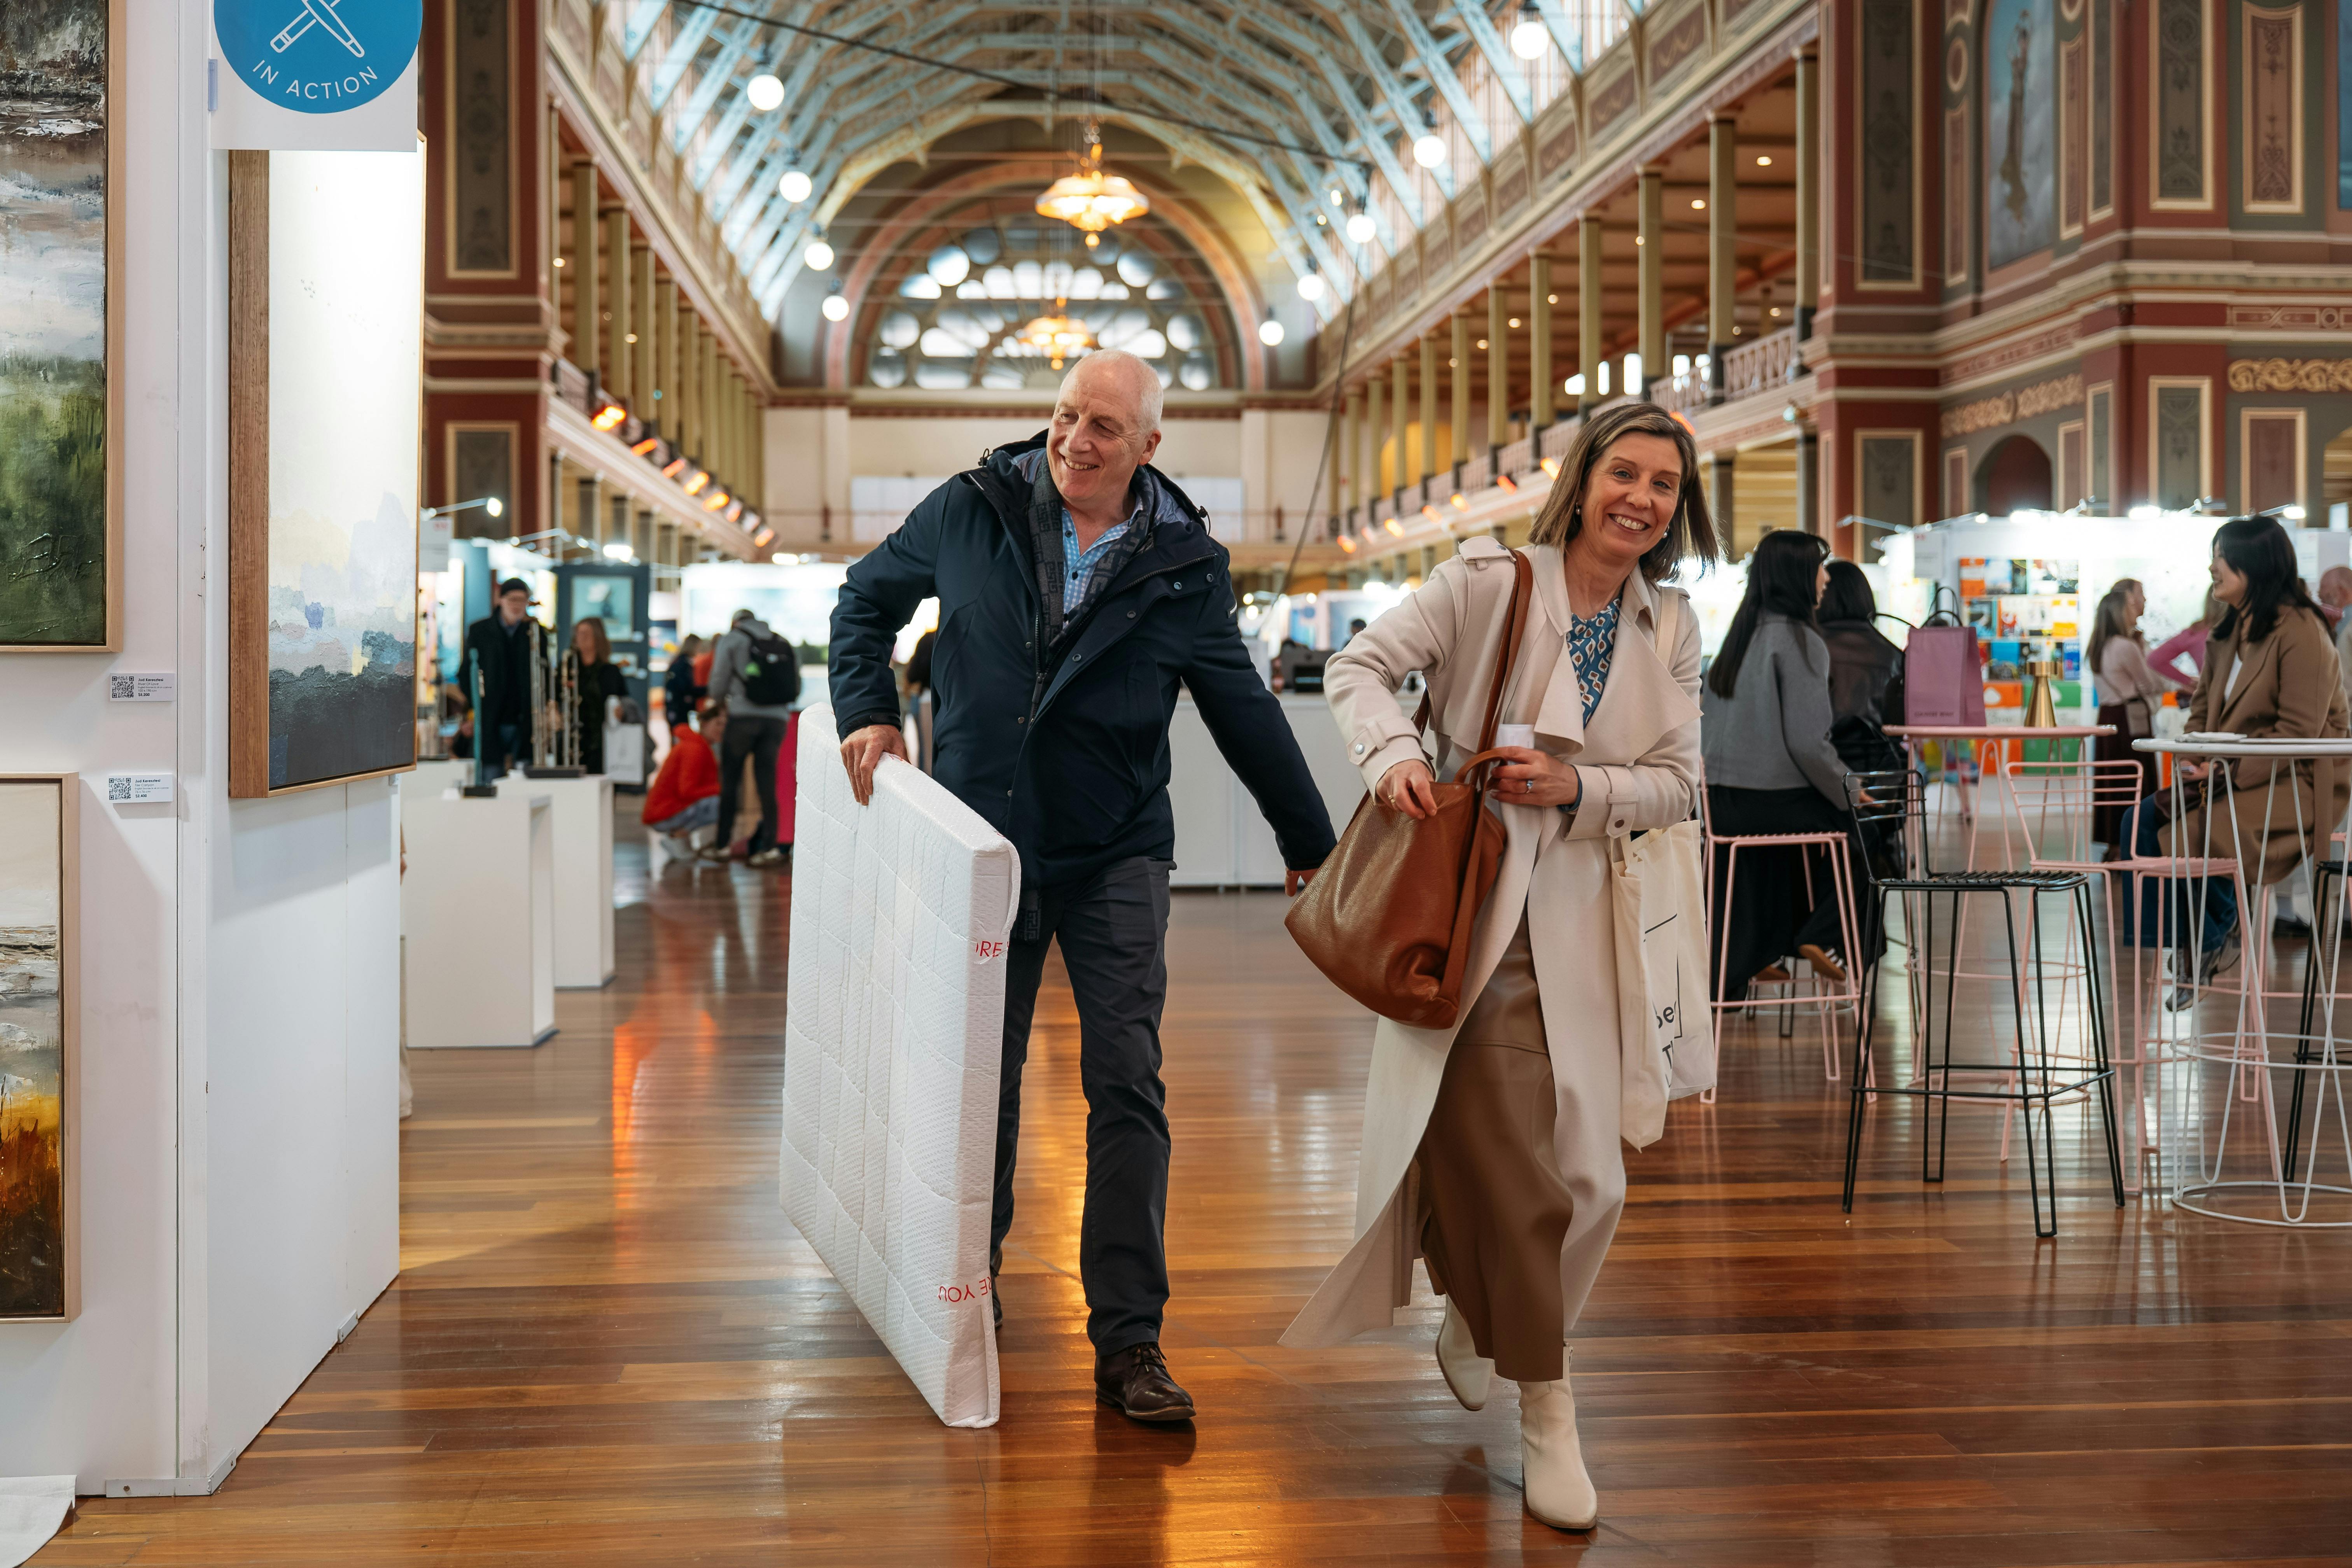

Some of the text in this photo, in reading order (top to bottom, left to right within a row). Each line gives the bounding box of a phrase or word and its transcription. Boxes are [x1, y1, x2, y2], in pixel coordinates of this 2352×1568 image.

[252, 59, 378, 99] IN ACTION
[976, 941, 1003, 957] RE
[938, 1284, 975, 1302] YOU
